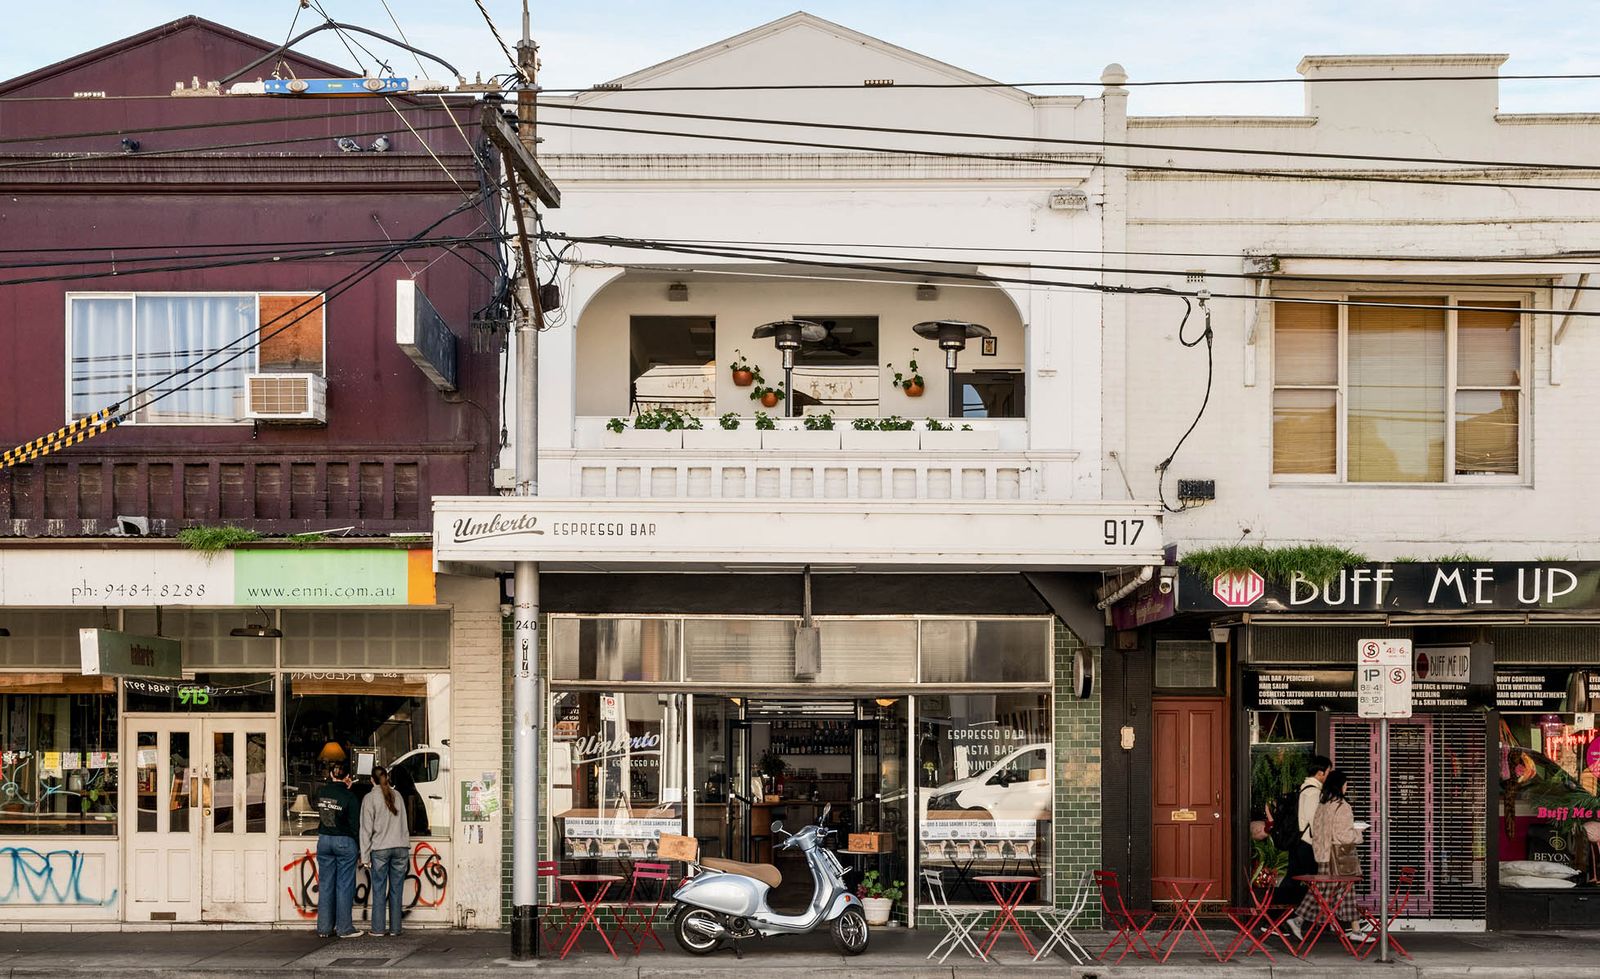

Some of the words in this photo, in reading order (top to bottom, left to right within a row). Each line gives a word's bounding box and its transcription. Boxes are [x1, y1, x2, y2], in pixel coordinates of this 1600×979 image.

[453, 513, 543, 542] Umberto
[553, 523, 624, 536] ESPRESSO
[630, 523, 656, 536] BAR
[1104, 519, 1144, 545] 917
[71, 578, 98, 604] ph:
[247, 583, 396, 597] www.enni.com.au
[1290, 568, 1394, 606] BUFF
[1427, 567, 1494, 605] ME
[1517, 567, 1578, 605] UP
[515, 620, 537, 631] 240
[521, 639, 529, 671] 917
[1364, 669, 1380, 682] 1P
[1430, 655, 1445, 677] BUFF
[1447, 655, 1457, 677] ME
[1458, 655, 1469, 677] UP
[178, 688, 209, 704] 915
[948, 730, 1000, 740] ESPRESSO
[1004, 730, 1024, 740] BAR
[575, 731, 661, 762] Umberto
[956, 745, 989, 755] ASTA
[1537, 806, 1569, 821] Buff
[1572, 806, 1593, 818] Me
